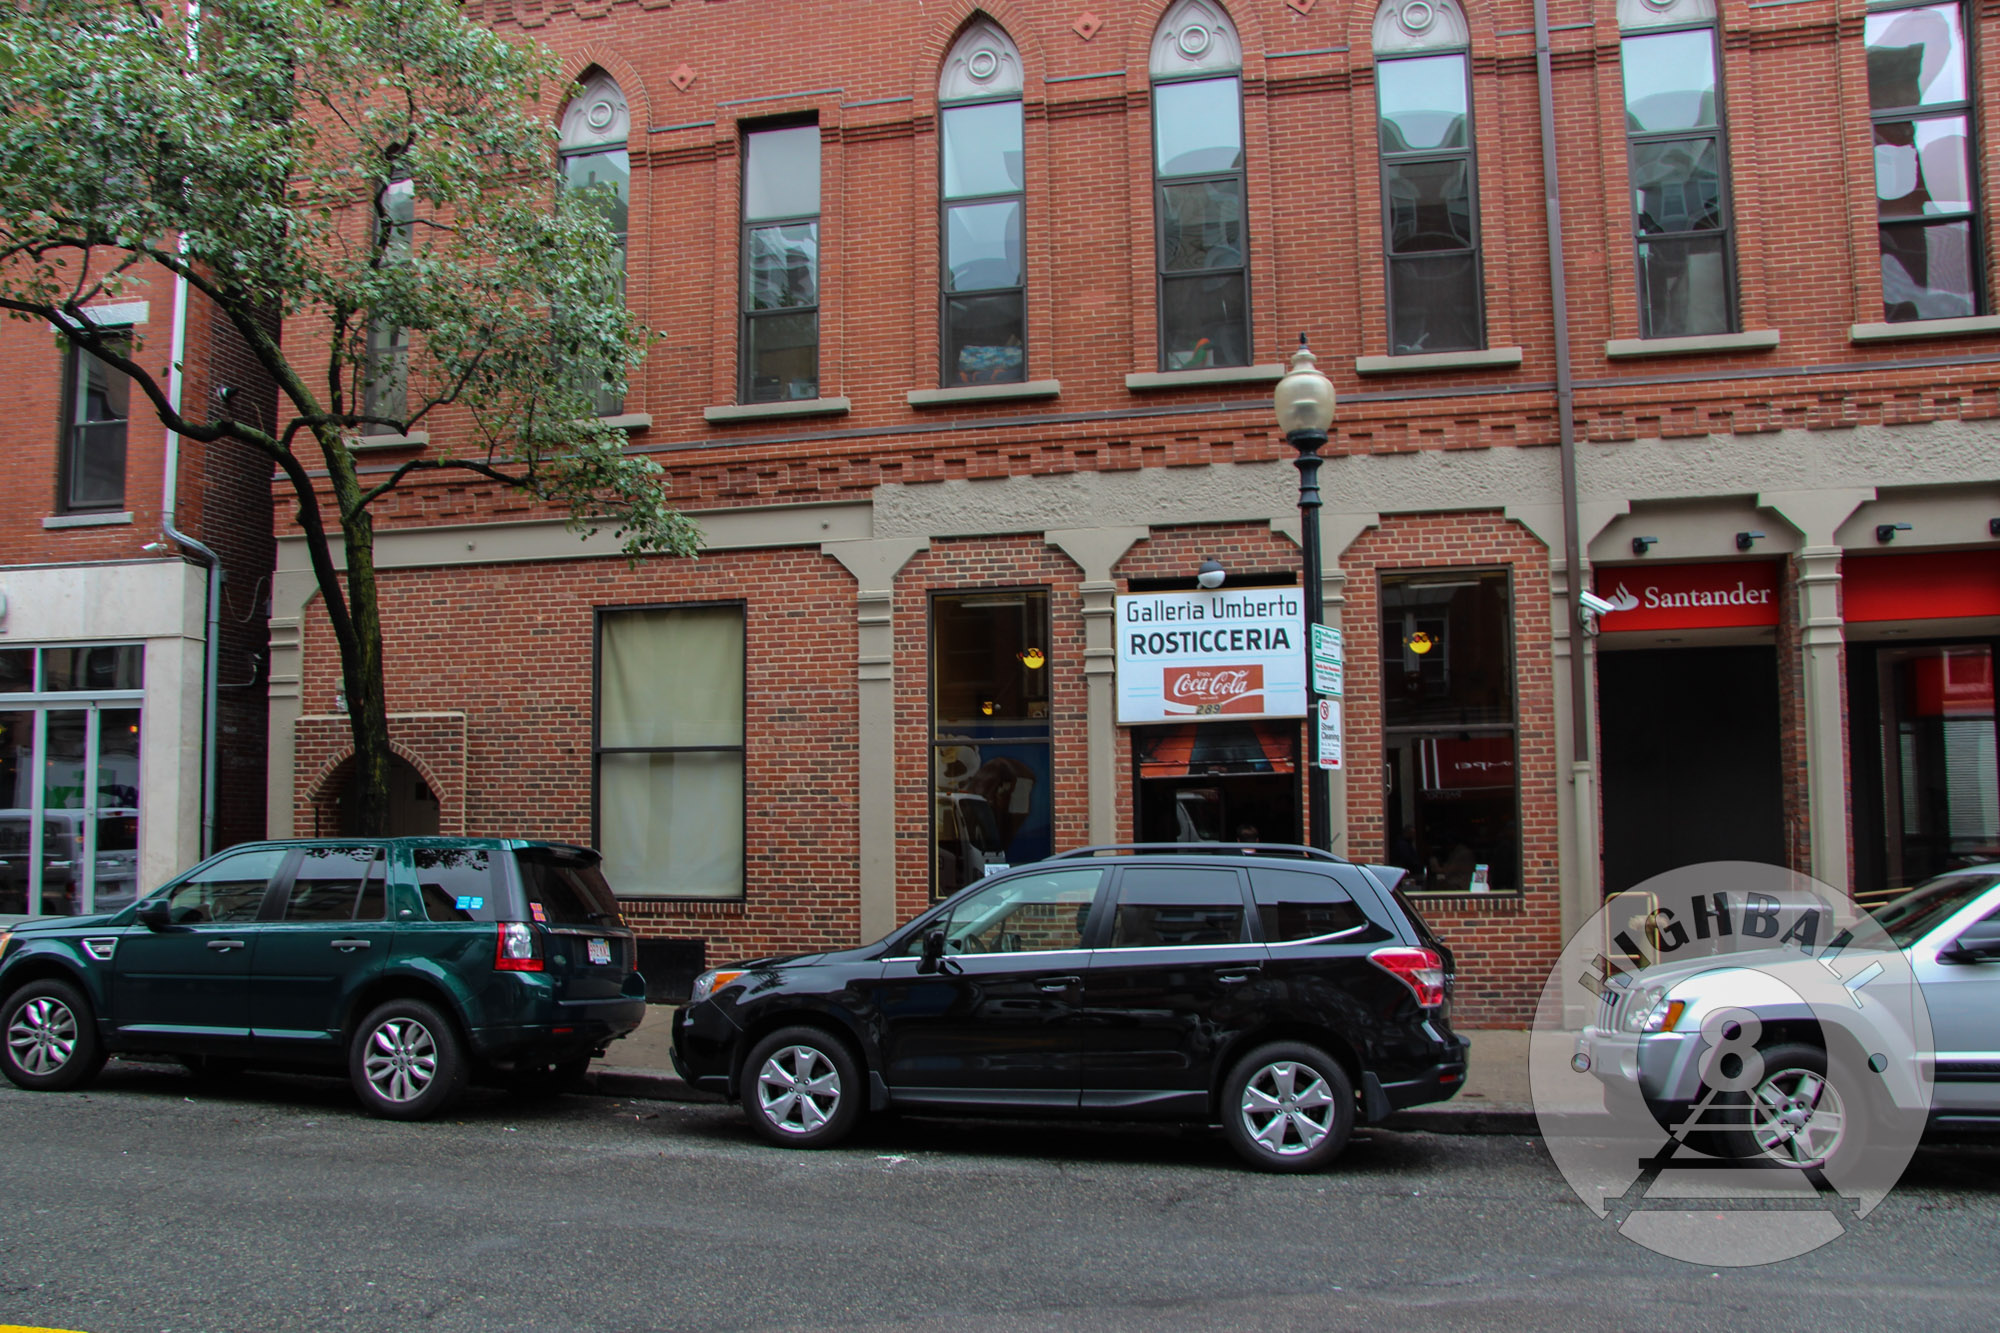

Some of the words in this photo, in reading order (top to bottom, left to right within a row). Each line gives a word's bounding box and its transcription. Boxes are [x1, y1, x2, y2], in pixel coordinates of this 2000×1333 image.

[1127, 600, 1204, 622] Galleria
[1212, 594, 1298, 619] Umberto
[1644, 581, 1771, 609] Santander
[1131, 628, 1290, 655] ROSTICCERIA
[1173, 669, 1249, 697] Coca-Cola
[1196, 704, 1221, 715] 289
